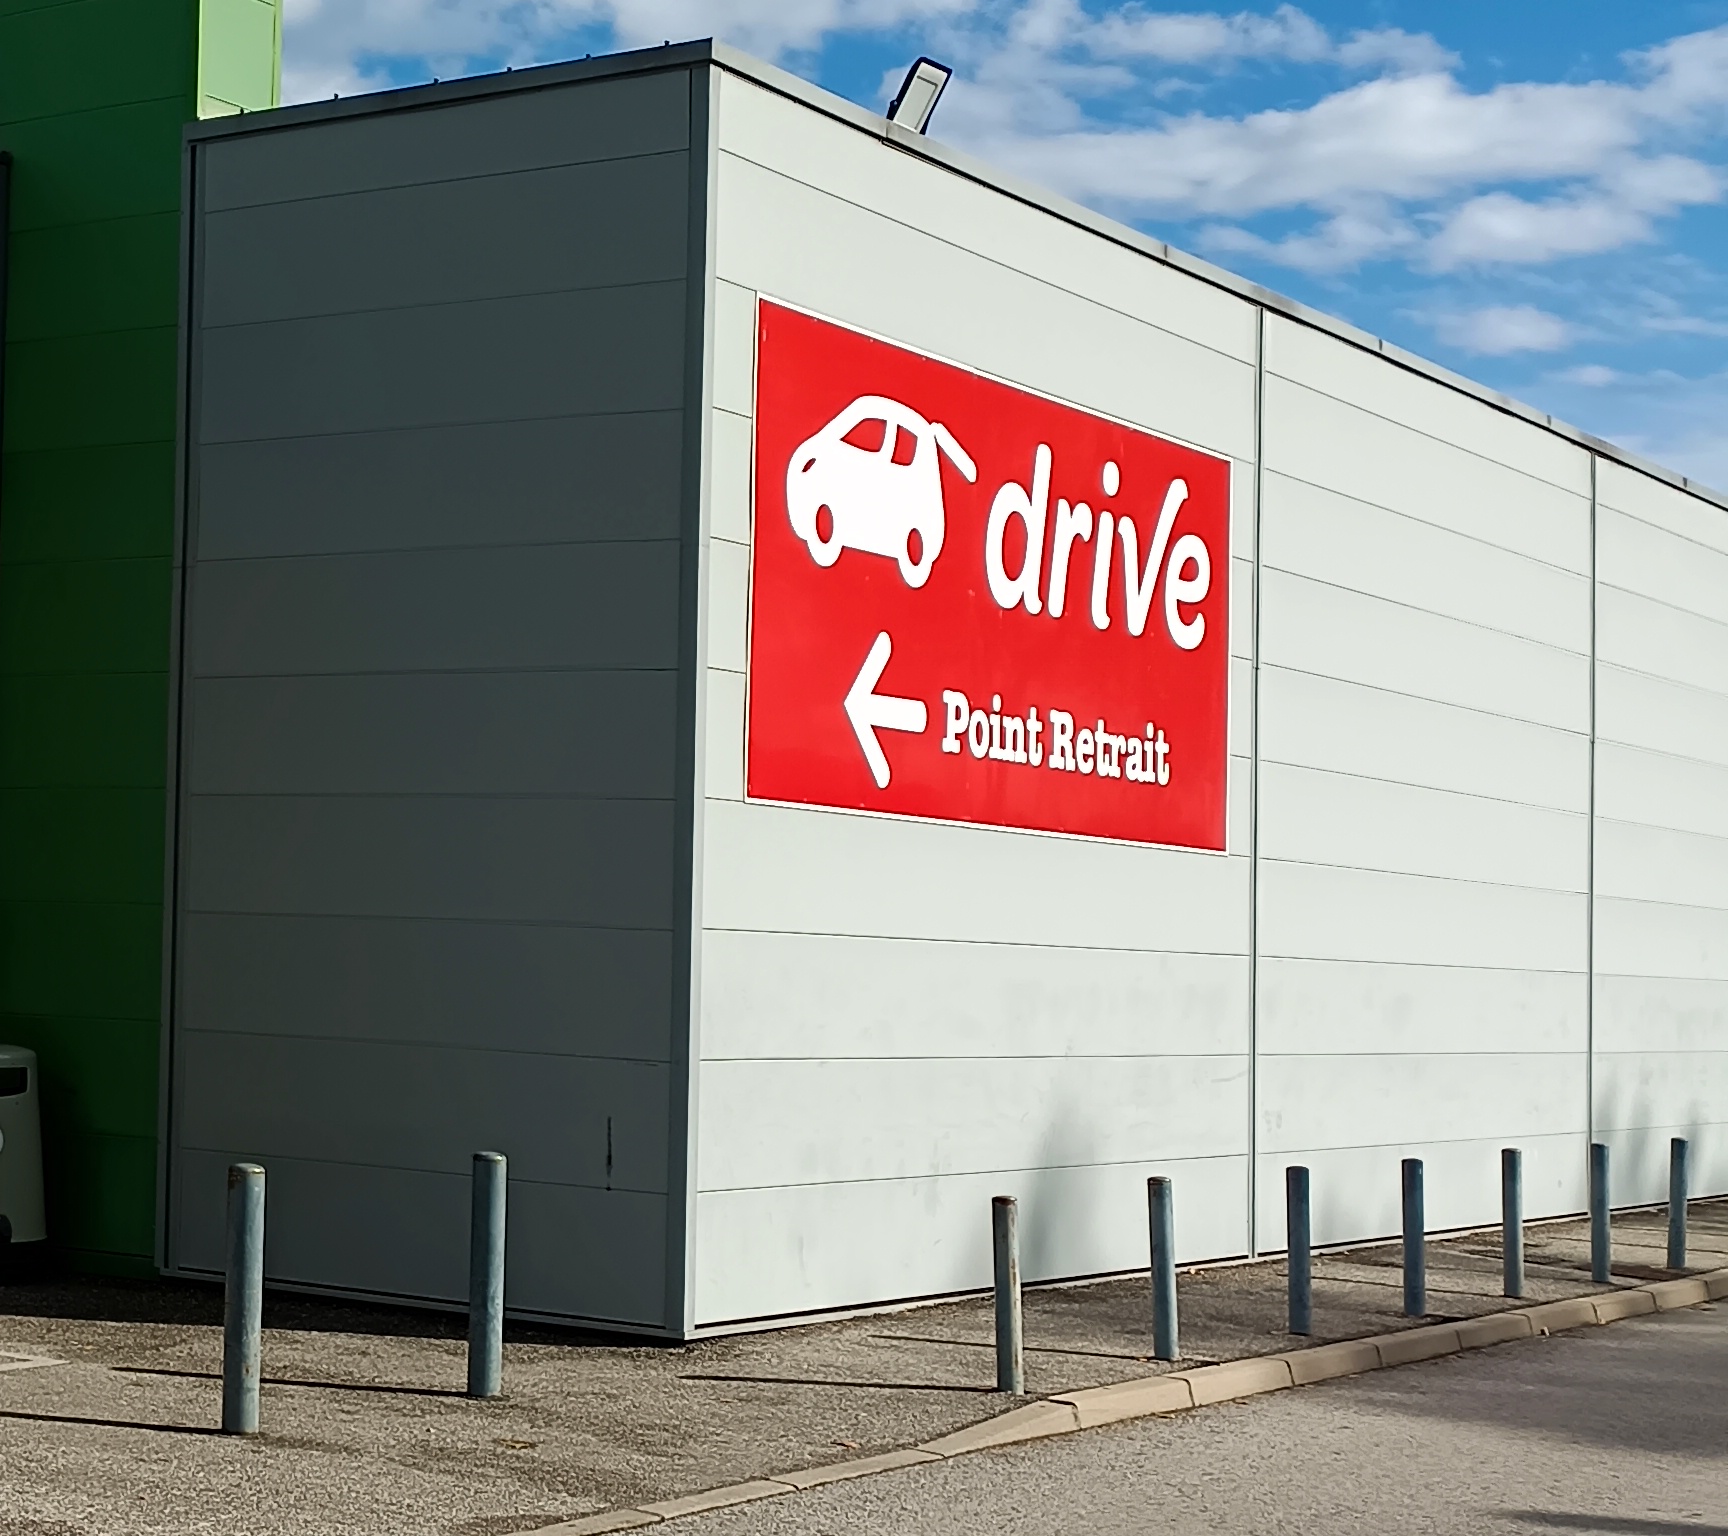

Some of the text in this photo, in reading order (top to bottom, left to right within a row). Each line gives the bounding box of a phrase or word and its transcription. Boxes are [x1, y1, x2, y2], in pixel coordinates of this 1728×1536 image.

[985, 443, 1210, 650] drive
[942, 689, 1170, 786] Point Retrait
